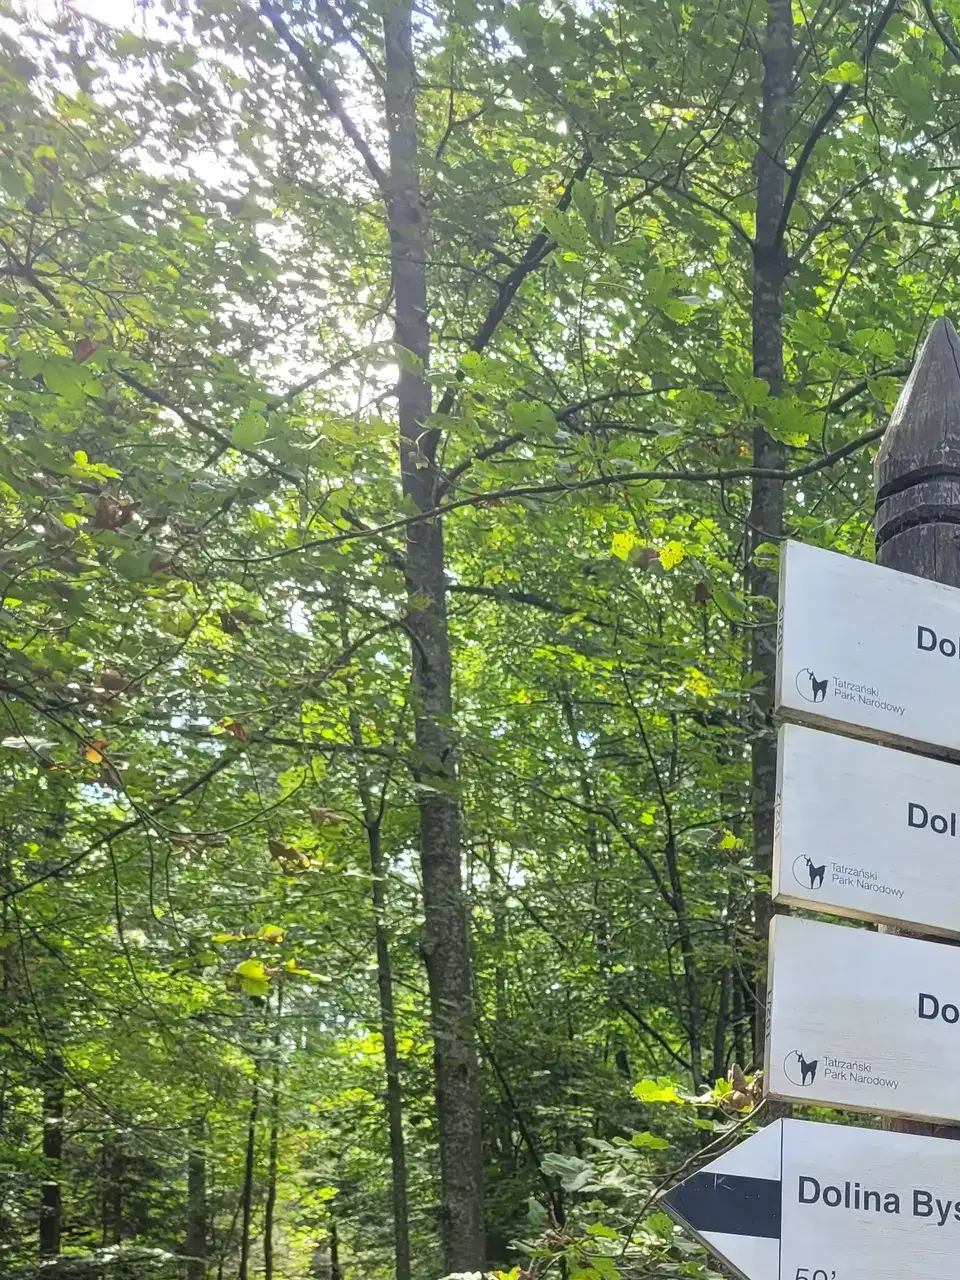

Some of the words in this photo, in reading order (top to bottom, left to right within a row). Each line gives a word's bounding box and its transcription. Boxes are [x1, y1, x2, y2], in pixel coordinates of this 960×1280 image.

[833, 677, 879, 697] Tatrzański
[834, 688, 856, 703] Park
[859, 692, 905, 716] Narodowy
[831, 862, 877, 880] Tatrzański
[832, 874, 854, 888] Park
[856, 878, 904, 899] Narodowy
[823, 1056, 871, 1073] Tatrzański
[824, 1068, 847, 1081] Park
[850, 1071, 899, 1090] Narodowy
[798, 1177, 900, 1214] Dolina
